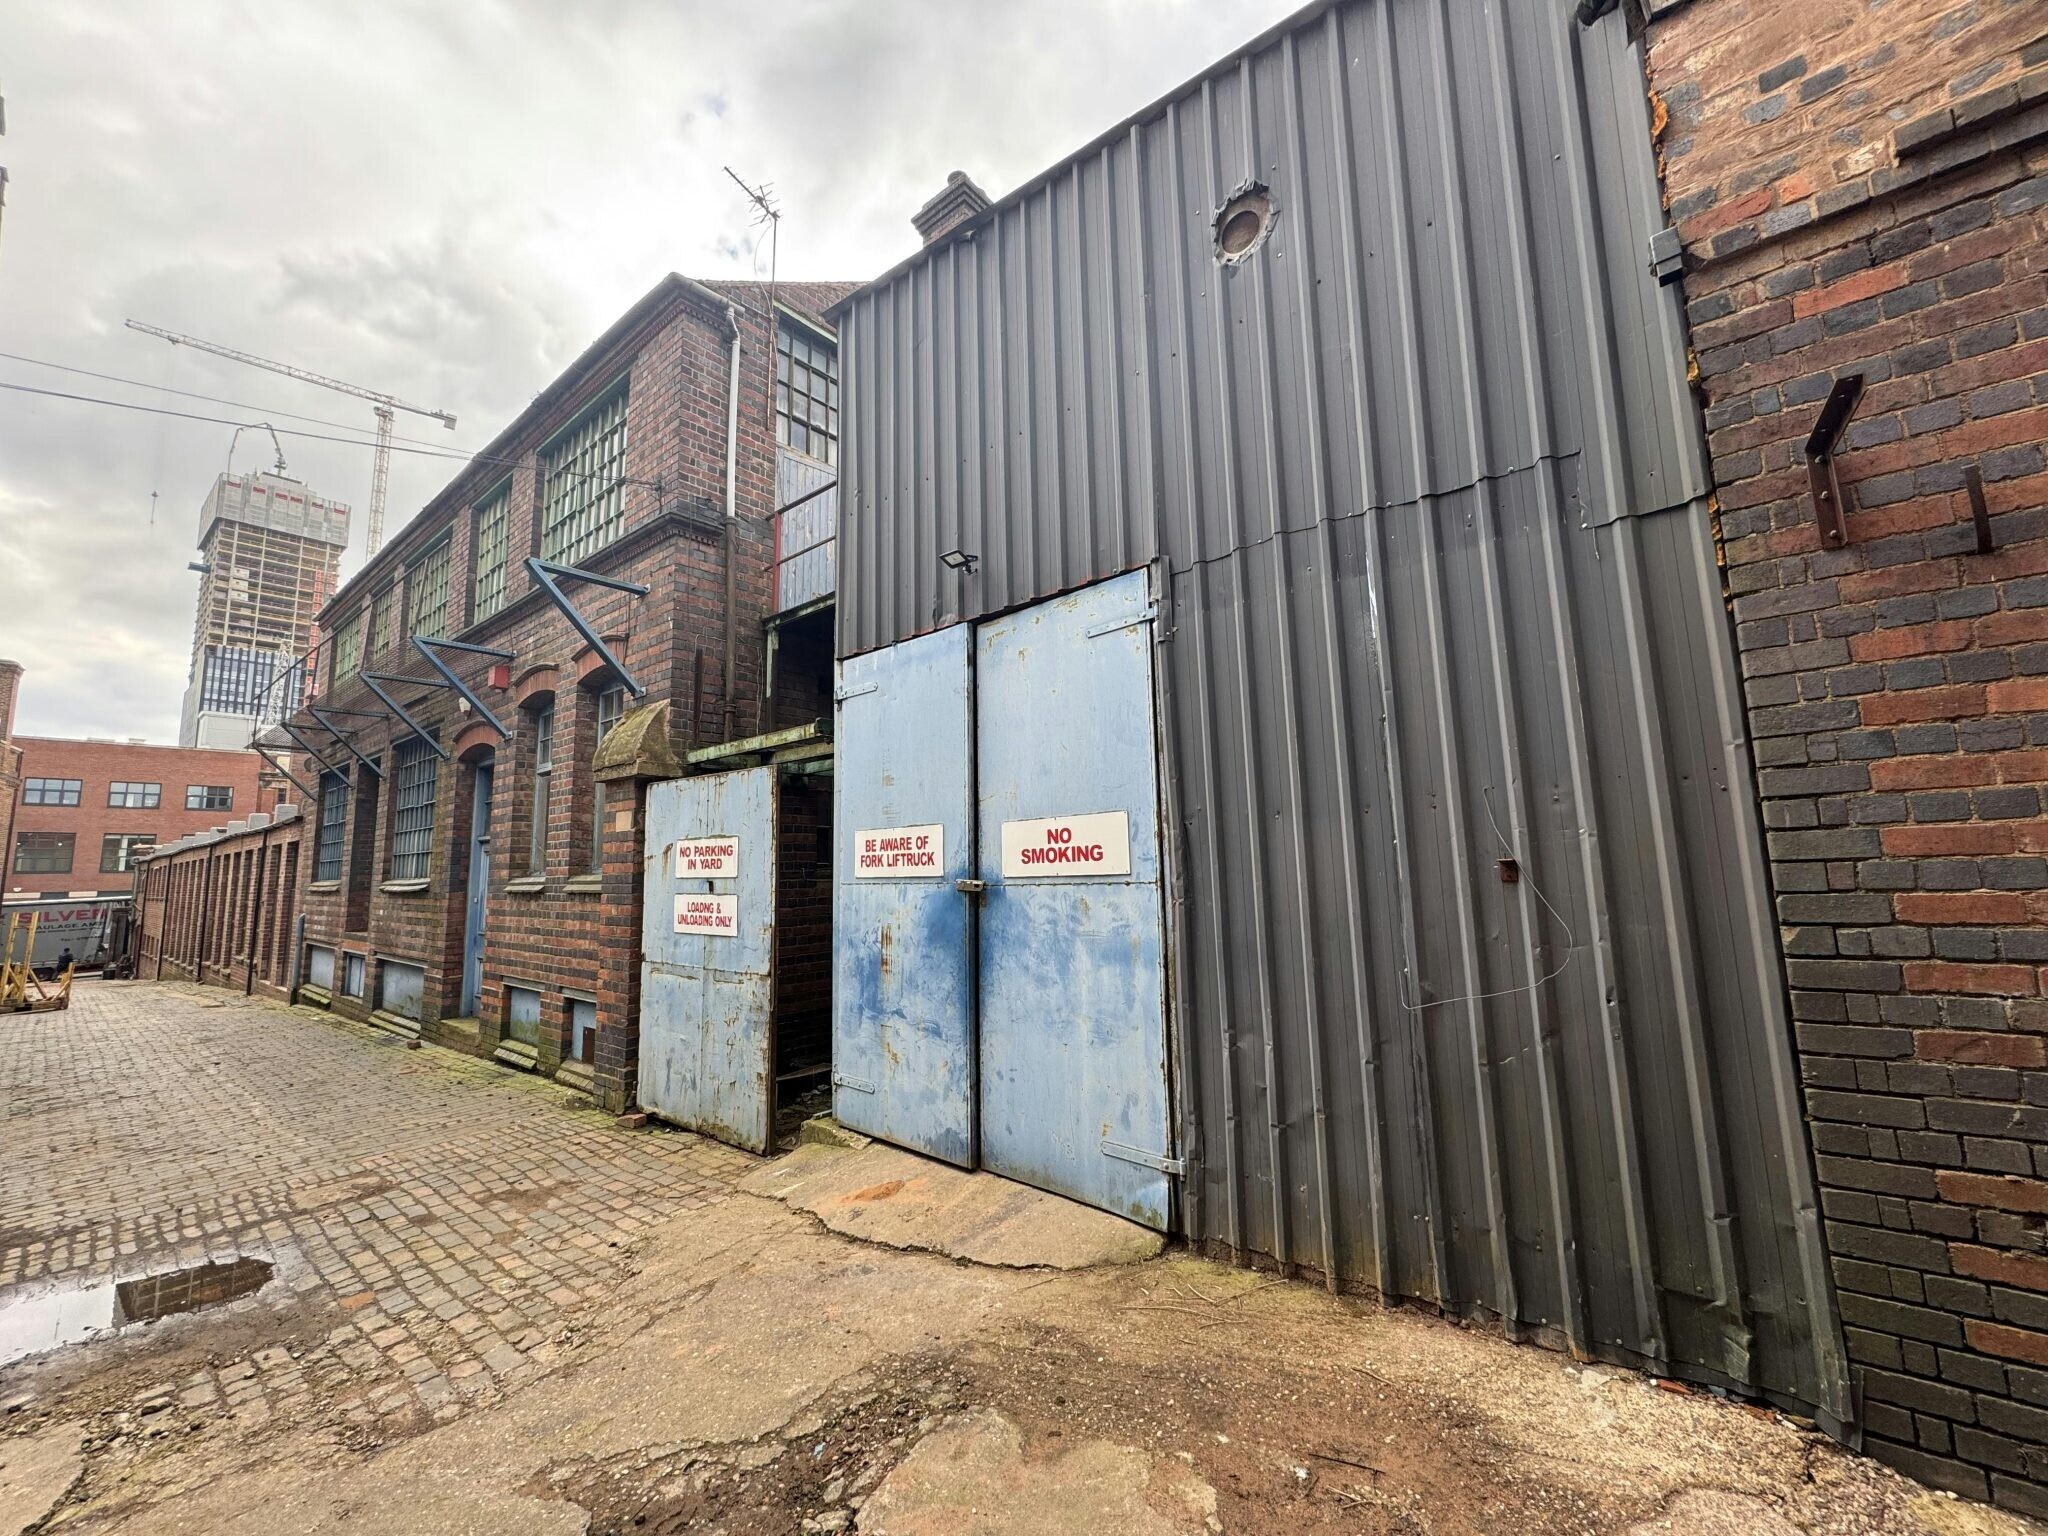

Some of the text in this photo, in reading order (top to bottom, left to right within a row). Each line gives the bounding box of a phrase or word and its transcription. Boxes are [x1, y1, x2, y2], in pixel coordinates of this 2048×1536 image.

[1047, 827, 1072, 844] NO
[680, 845, 733, 857] NO PARKING
[865, 835, 929, 853] BE AWARE OF
[860, 851, 935, 868] FORK LIFTRUCK
[1021, 844, 1104, 865] SMOKING
[688, 858, 722, 869] IN YARD
[716, 903, 721, 914] &
[678, 914, 732, 927] UNLOADING ONLY
